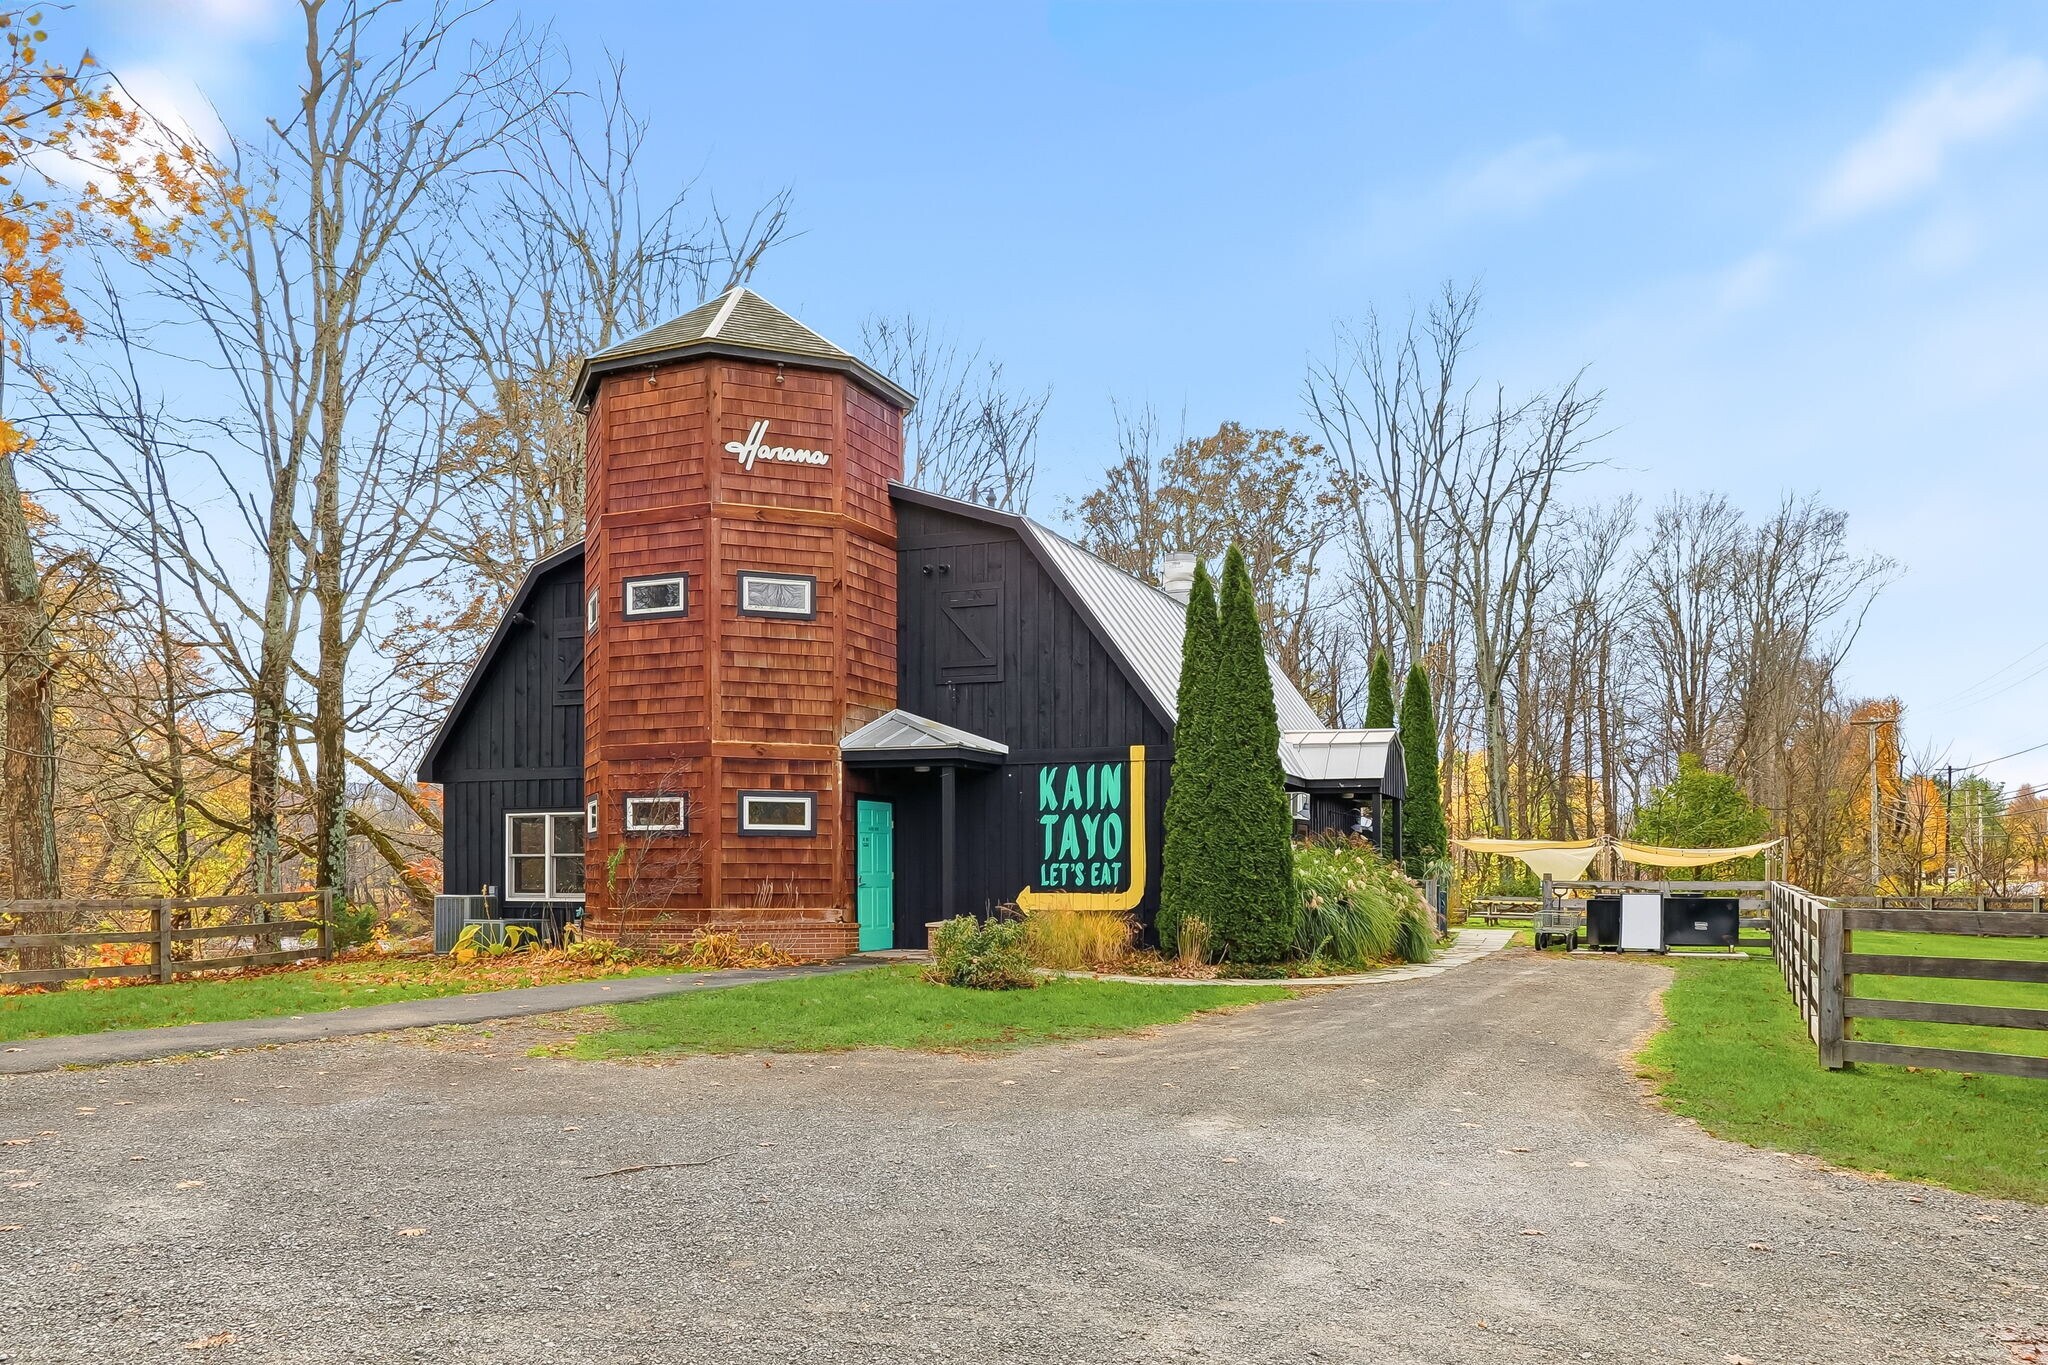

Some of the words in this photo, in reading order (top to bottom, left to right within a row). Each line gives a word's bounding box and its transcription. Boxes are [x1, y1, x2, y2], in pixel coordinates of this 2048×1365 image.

[724, 420, 829, 471] Harana
[1039, 763, 1122, 811] KAIN
[1039, 812, 1123, 860] TAYO
[1040, 862, 1085, 887] LET'S
[1090, 862, 1121, 887] EAT
